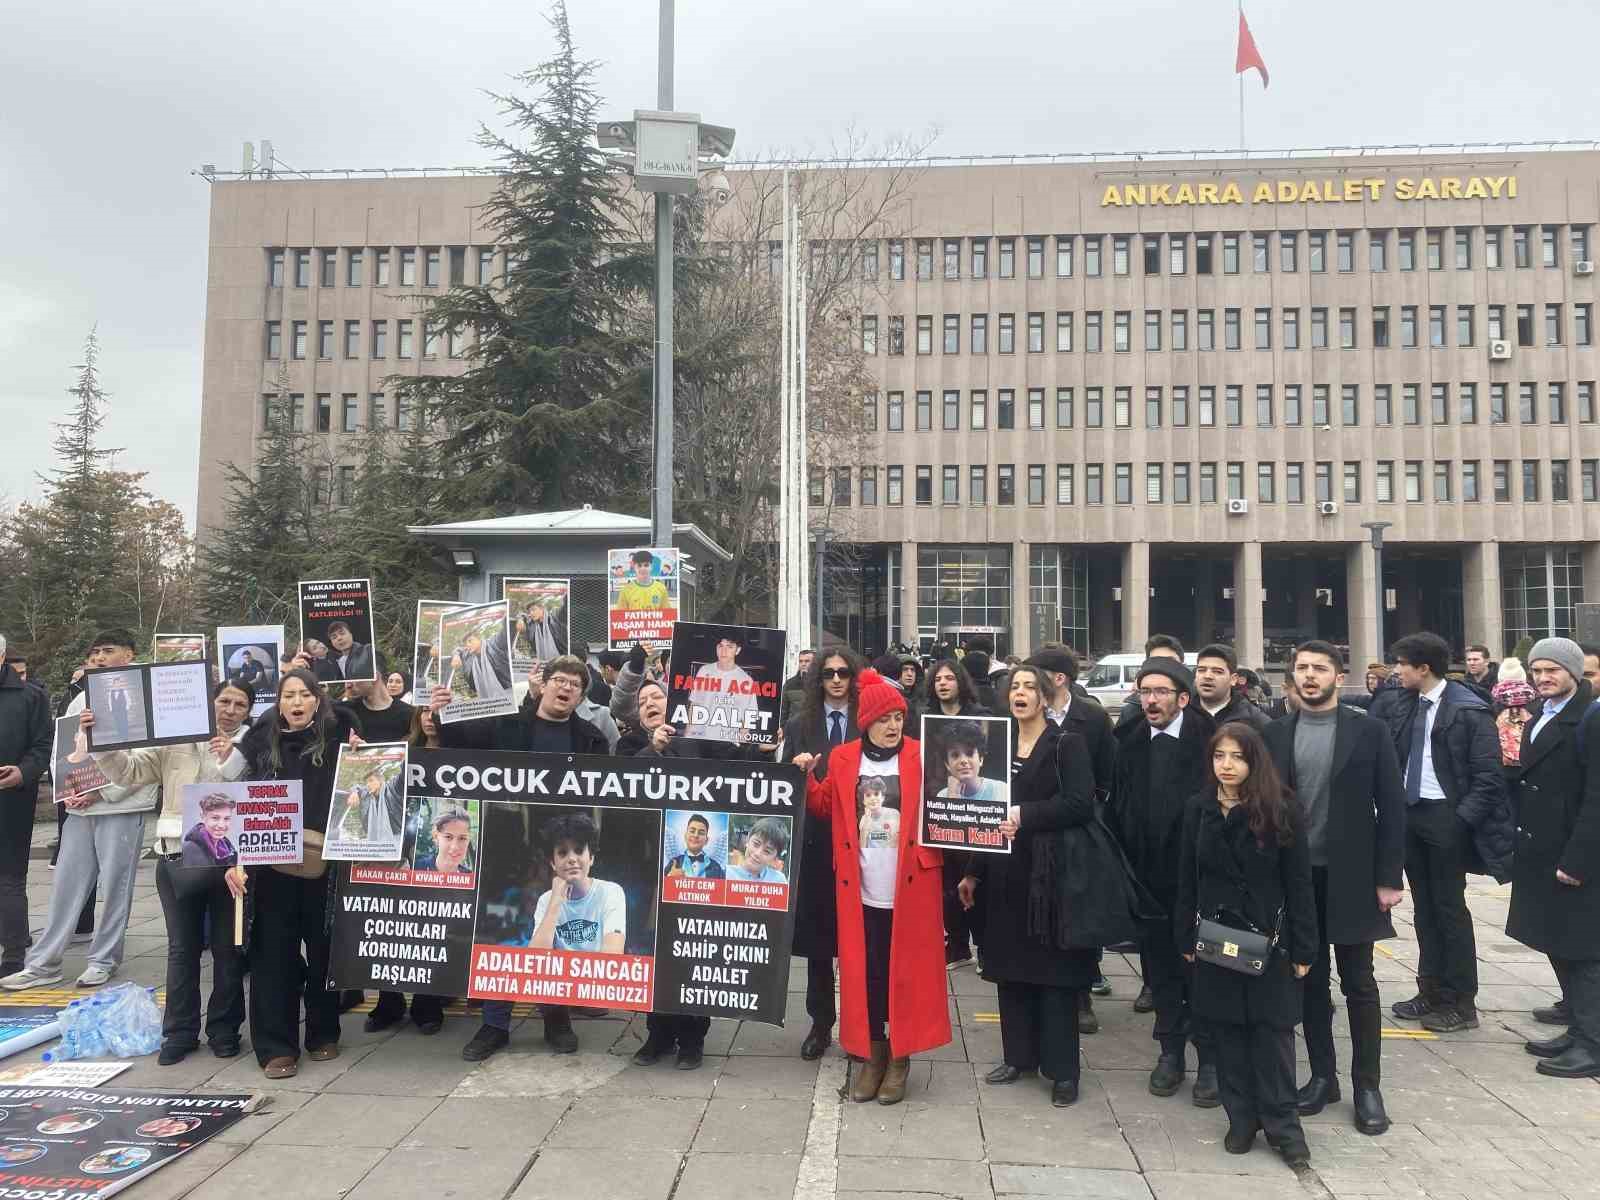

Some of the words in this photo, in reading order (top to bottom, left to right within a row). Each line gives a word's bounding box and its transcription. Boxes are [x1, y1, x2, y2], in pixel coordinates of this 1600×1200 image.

[1101, 183, 1244, 208] ANKARA
[1253, 179, 1386, 205] ADALET
[1395, 176, 1517, 202] SARAYI
[337, 582, 361, 591] ÇAKIR
[341, 599, 355, 607] İÇİN
[612, 621, 645, 631] YAŞAM
[629, 630, 660, 639] ALINDI
[616, 640, 638, 649] ADALET
[674, 672, 722, 692] FATİH
[670, 704, 773, 730] ADALET
[435, 765, 550, 796] ÇOCUK
[238, 832, 298, 846] ADALET
[239, 846, 261, 854] HALA
[356, 869, 383, 880] HAKAN
[385, 871, 407, 881] ÇAKIR
[415, 873, 443, 883] KIVANÇ
[447, 875, 470, 884] UMAN
[698, 880, 716, 890] CEM
[731, 883, 761, 893] MURAT
[762, 885, 784, 896] DUHA
[343, 896, 394, 914] VATANI
[398, 899, 472, 919] KORUMAK
[744, 896, 770, 907] YILDIZ
[364, 919, 447, 940] ÇOCUKLARI
[677, 918, 768, 940] VATANIMIZA
[358, 941, 448, 963] KORUMAKLA
[672, 940, 718, 959] SAHİP
[723, 944, 770, 965] ÇIKIN!
[370, 964, 432, 985] BAŞLAR!
[476, 951, 564, 976] ADALETİN
[570, 957, 650, 983] SANCAĞI
[691, 965, 750, 986] ADALET
[474, 974, 519, 993] MATİA
[522, 979, 573, 998] AHMET
[577, 980, 648, 1003] MİNGUZZİ
[680, 983, 760, 1010] İSTİYORUZ
[119, 1096, 250, 1108] KALANLARIN
